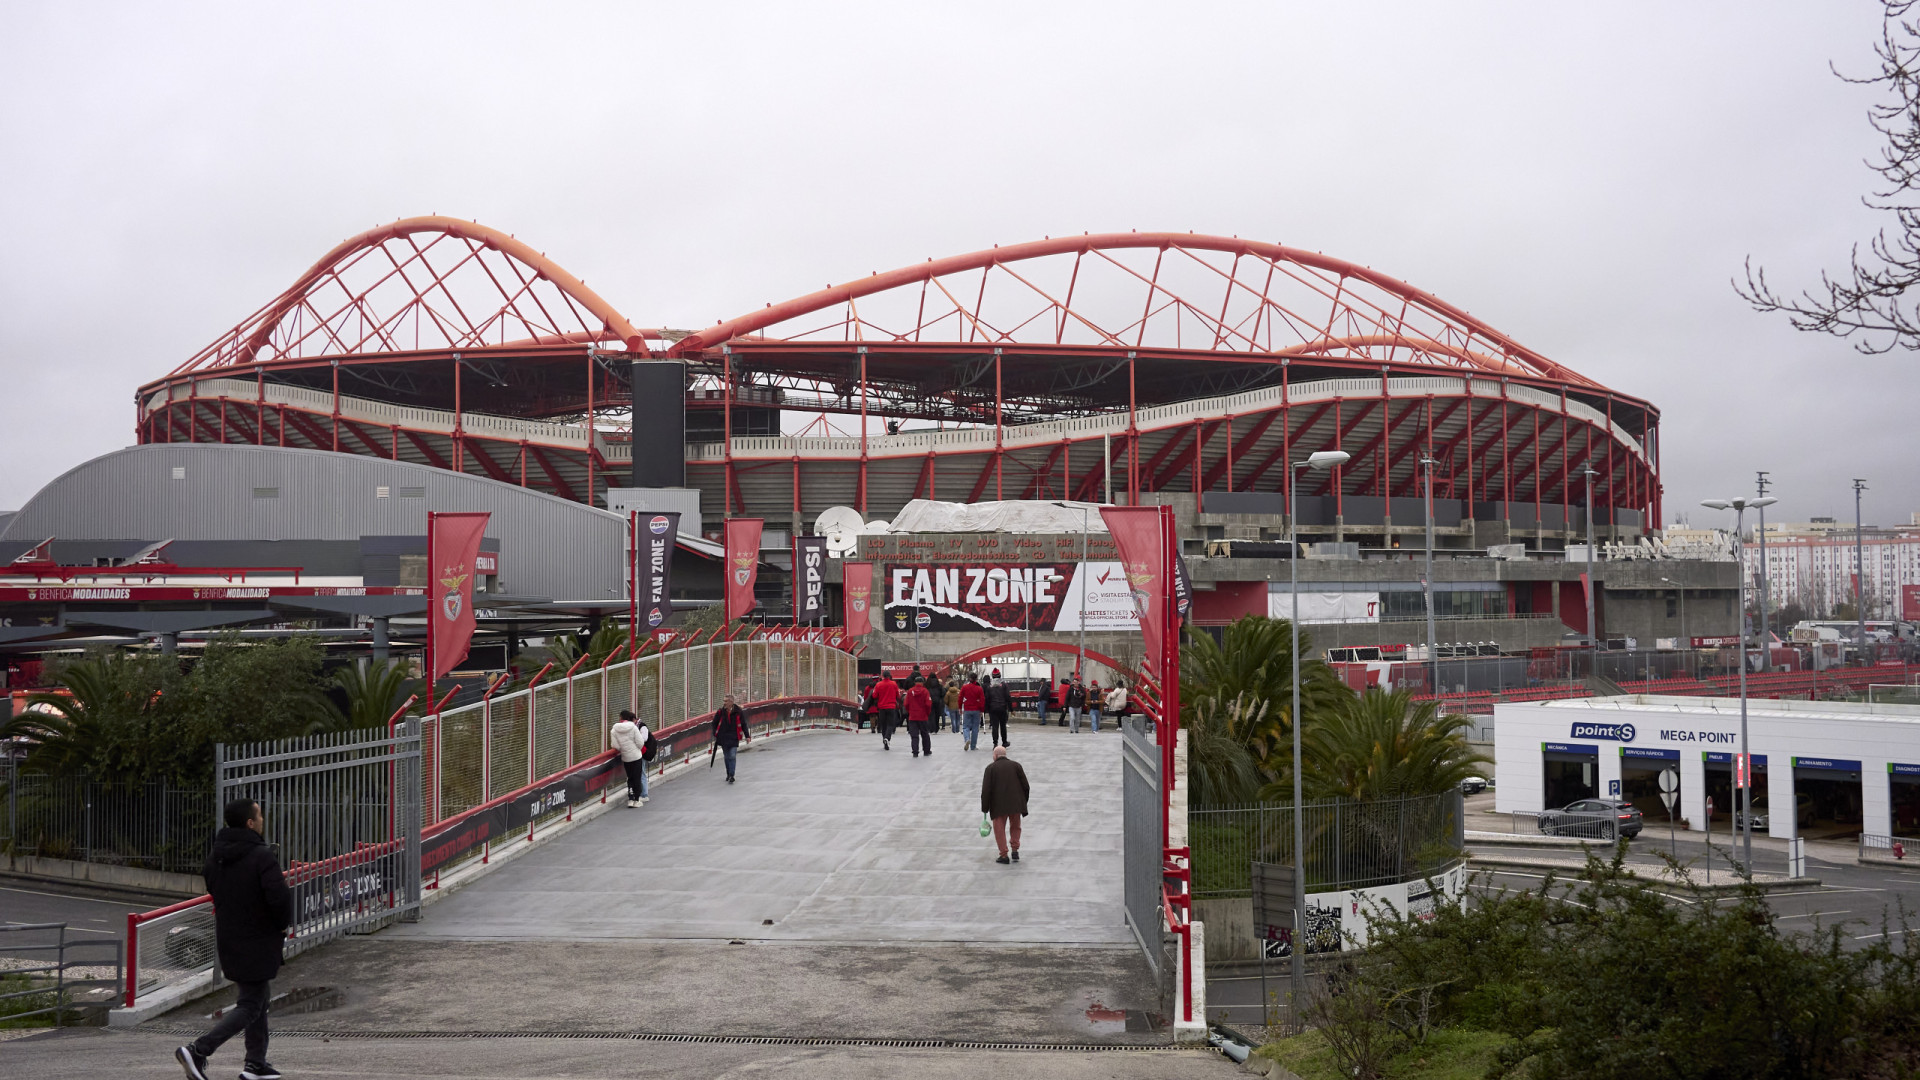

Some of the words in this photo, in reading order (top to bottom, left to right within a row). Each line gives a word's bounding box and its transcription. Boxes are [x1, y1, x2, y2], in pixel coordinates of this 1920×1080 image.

[867, 539, 885, 548] LCD
[899, 539, 935, 548] Plasma
[949, 539, 963, 547] TV
[976, 539, 998, 548] DVD
[651, 538, 665, 572] ZONE
[1031, 550, 1046, 559] CD
[805, 546, 821, 611] PEPSI
[892, 568, 959, 604] FAN
[965, 567, 1056, 604] ZONE
[40, 588, 73, 600] BENFICA
[72, 588, 131, 600] MODALIDADES
[225, 588, 271, 599] MODALIDADES
[652, 576, 664, 603] FAN
[1660, 729, 1696, 743] MEGA
[1699, 731, 1737, 744] POINT
[530, 800, 541, 818] FAN
[552, 788, 566, 807] ZONE
